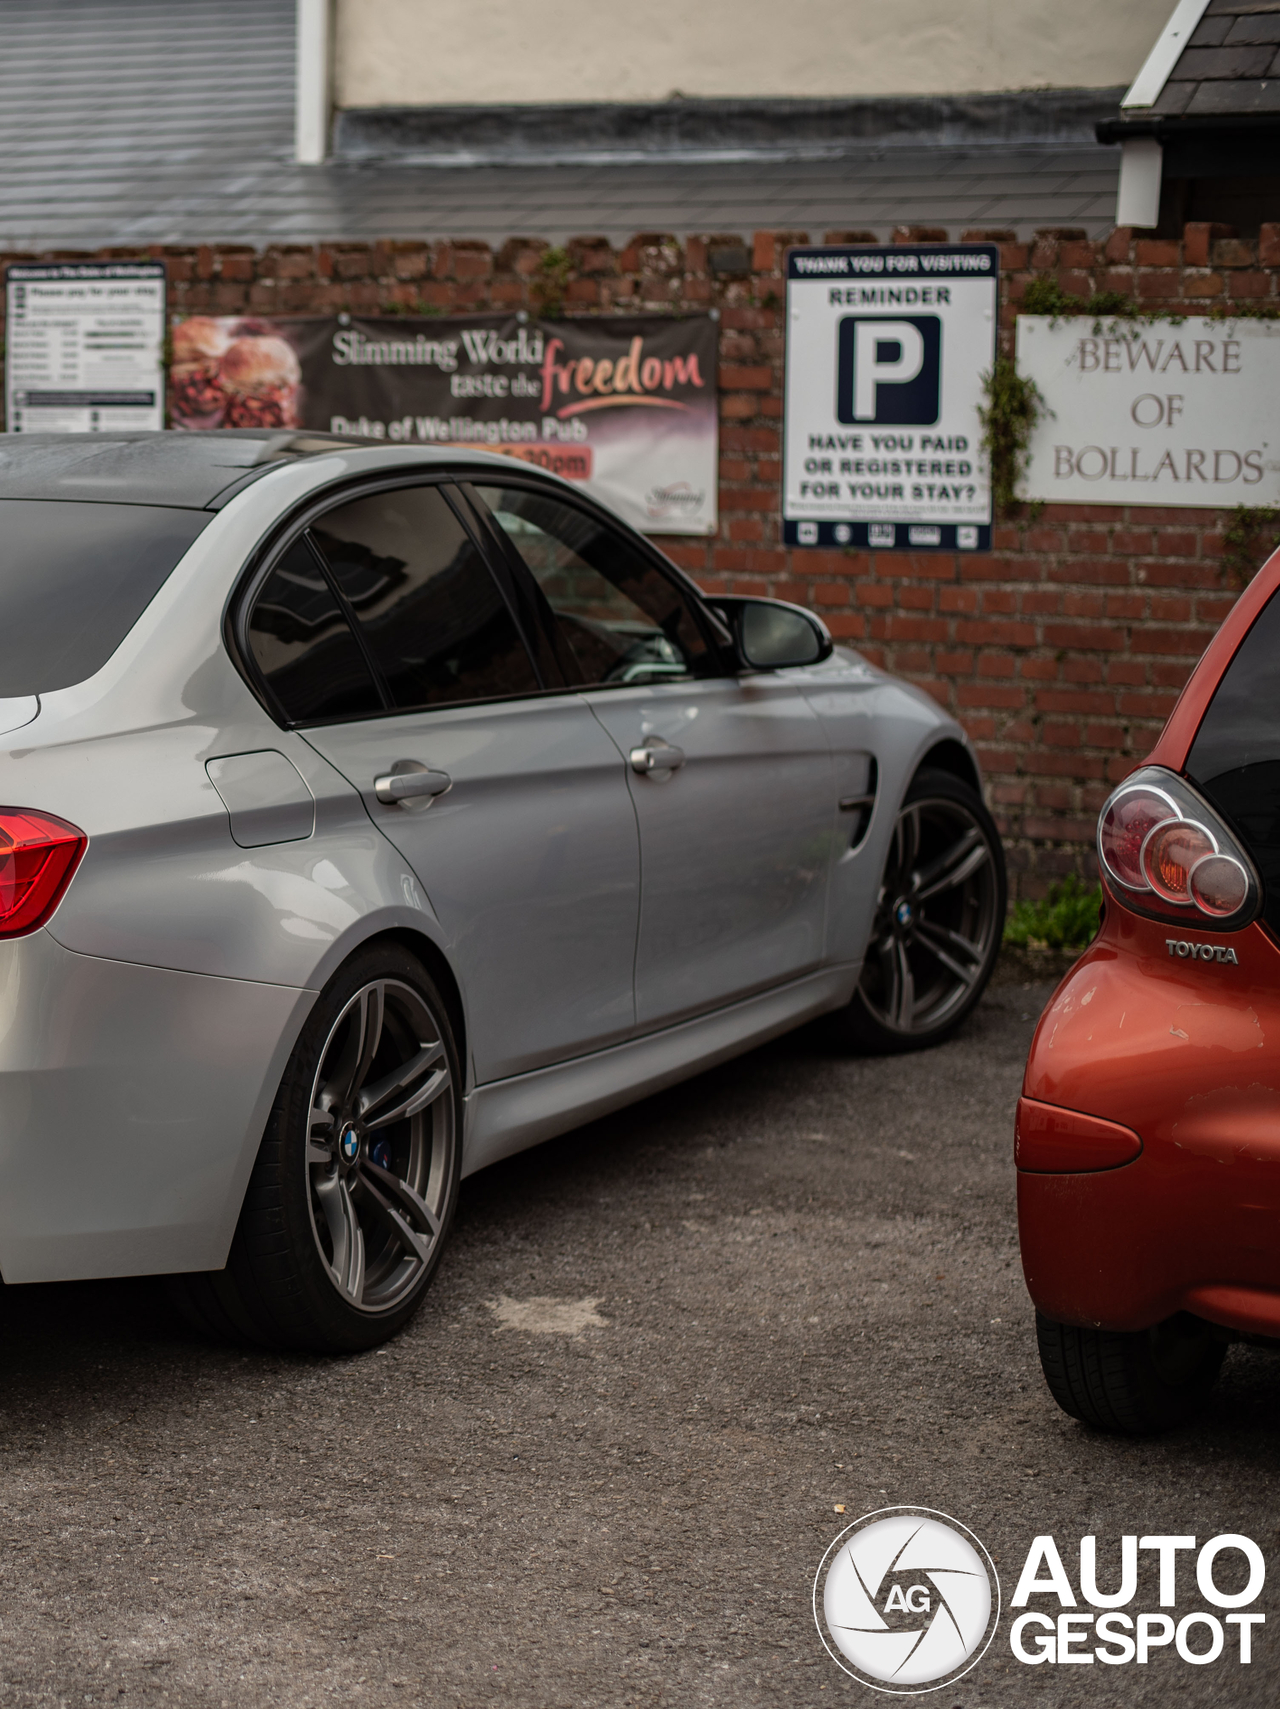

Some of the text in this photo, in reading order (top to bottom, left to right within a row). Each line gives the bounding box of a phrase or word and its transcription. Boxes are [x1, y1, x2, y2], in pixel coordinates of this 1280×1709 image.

[794, 254, 991, 273] THANK YOU FOR VISITING
[828, 286, 951, 306] REMINDER
[332, 329, 544, 371] Slimming World
[1078, 338, 1243, 374] BEWARE
[450, 370, 542, 398] taste the
[539, 335, 705, 412] freedom
[852, 320, 924, 422] P
[1130, 392, 1185, 429] OF
[331, 415, 588, 446] Duke of Wellington Pub
[808, 433, 968, 452] HAVE YOU PAID
[804, 456, 972, 477] OR REGISTERED
[1053, 445, 1264, 485] BOLLARDS
[799, 481, 976, 502] FOR YOUR STAY?
[1166, 939, 1238, 964] TOYOTA
